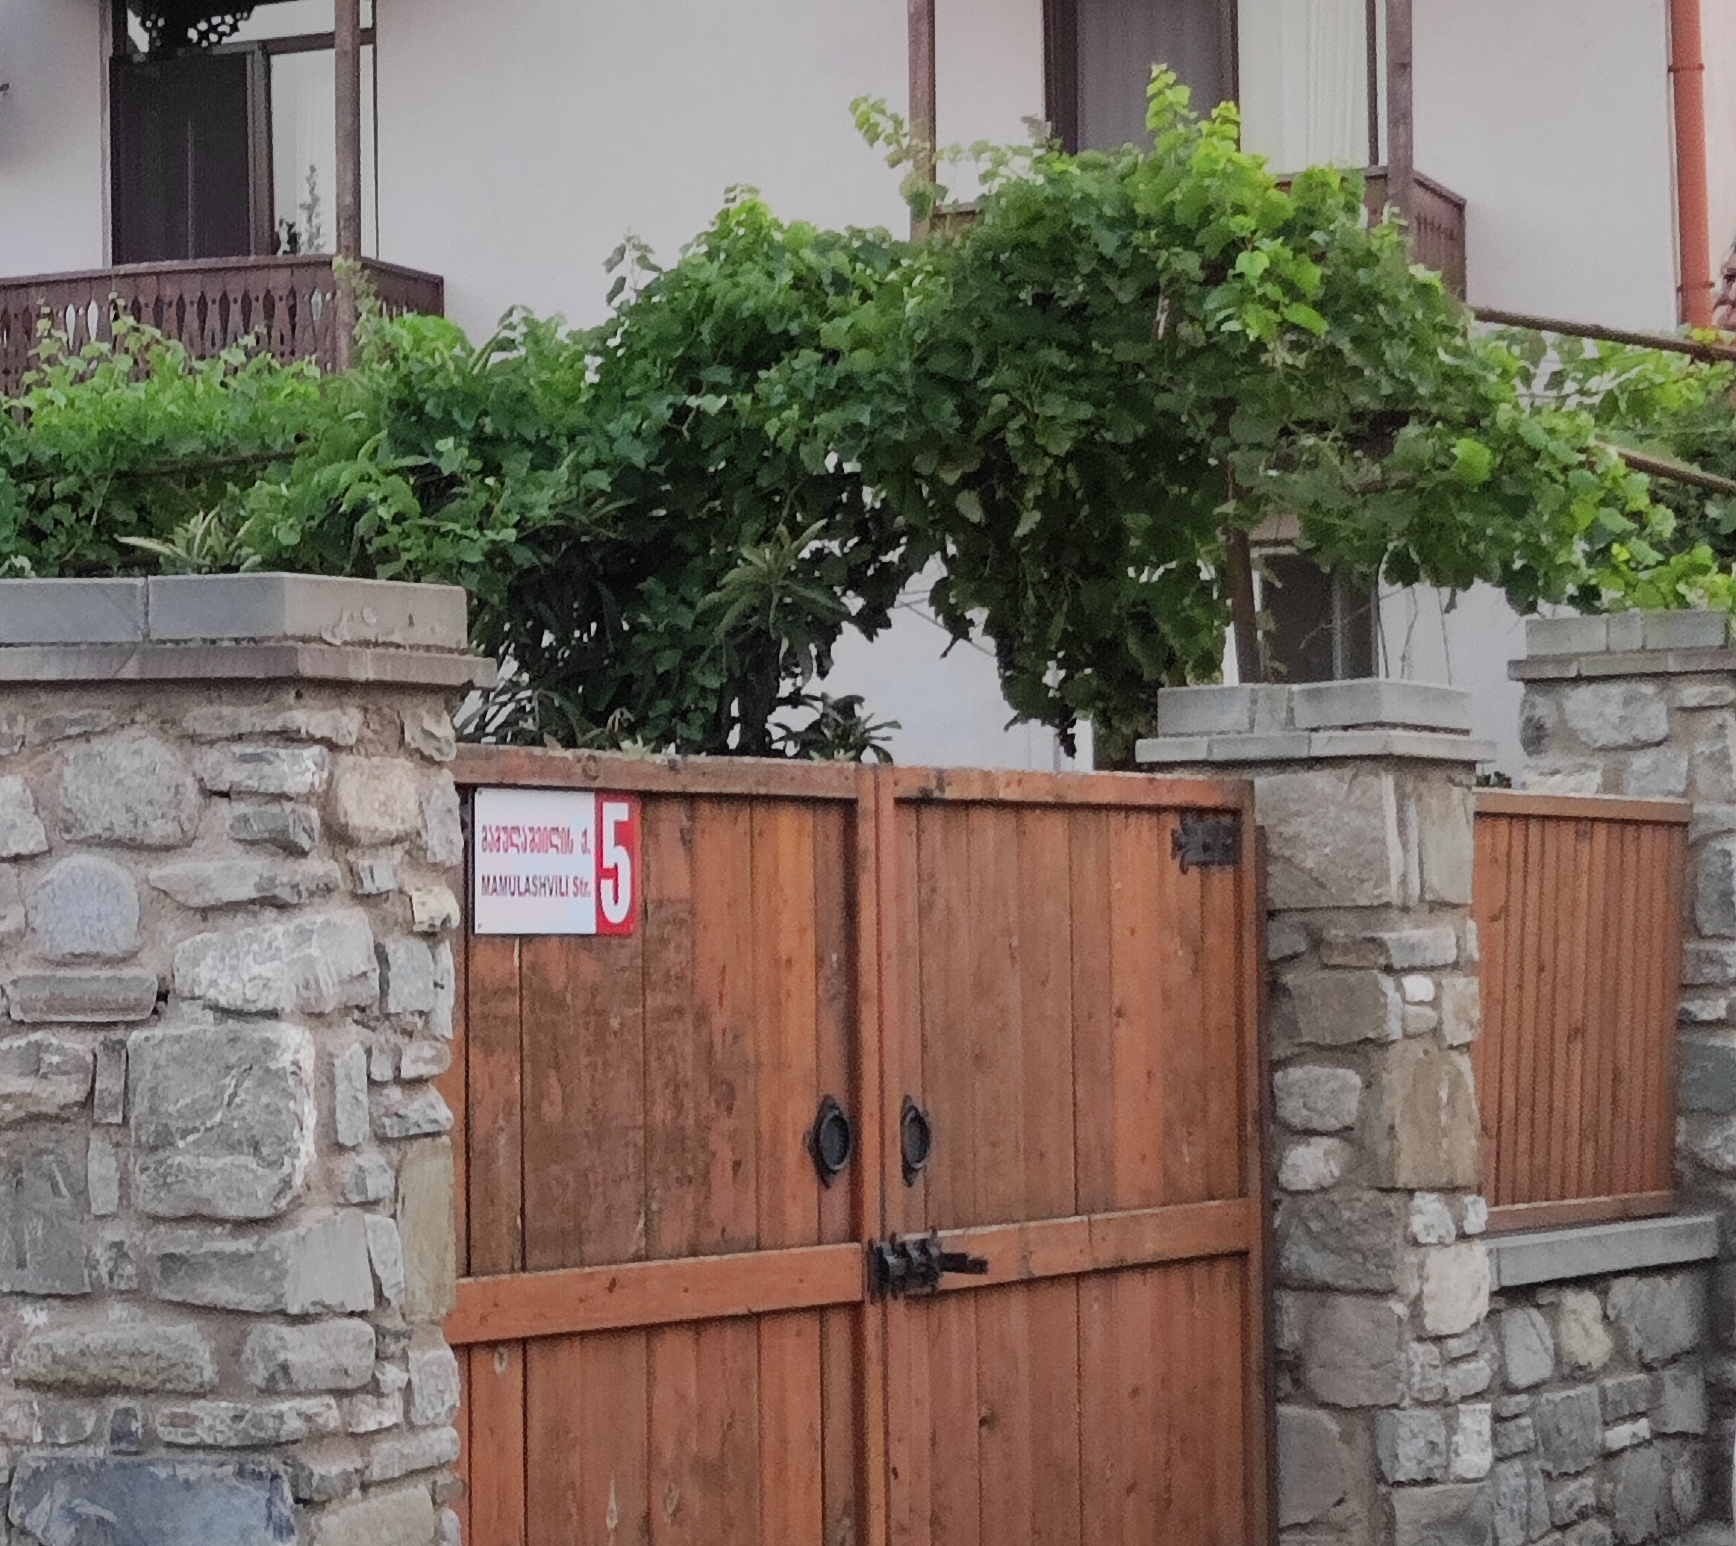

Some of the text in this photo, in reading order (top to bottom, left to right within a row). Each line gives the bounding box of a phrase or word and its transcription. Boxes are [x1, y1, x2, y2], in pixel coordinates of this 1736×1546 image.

[481, 824, 574, 855] მამულაშვილის
[600, 802, 631, 924] 5
[481, 874, 591, 898] MAMULASHVILI Str.
